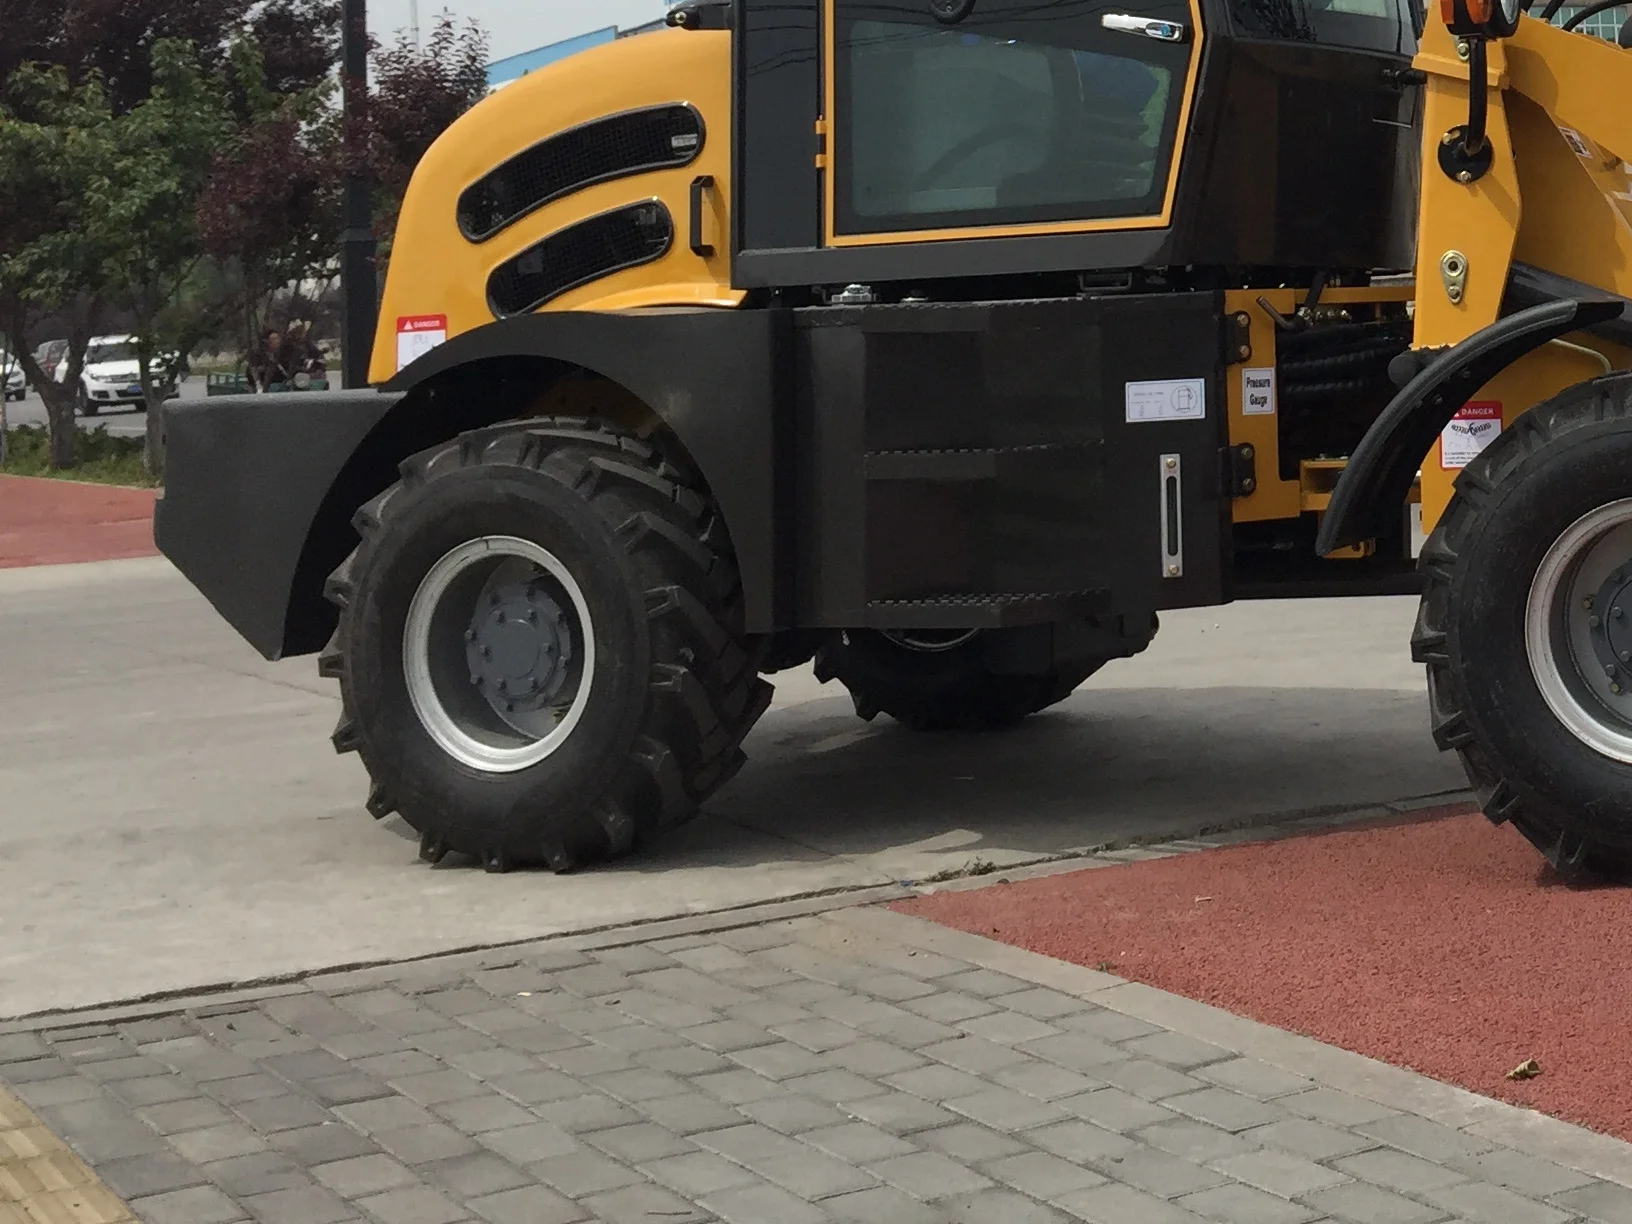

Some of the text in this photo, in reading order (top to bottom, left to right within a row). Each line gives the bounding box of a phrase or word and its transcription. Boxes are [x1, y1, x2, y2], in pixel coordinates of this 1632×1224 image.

[1246, 376, 1271, 388] Pressure
[1249, 393, 1268, 408] Gauge
[1461, 407, 1494, 416] DANGER
